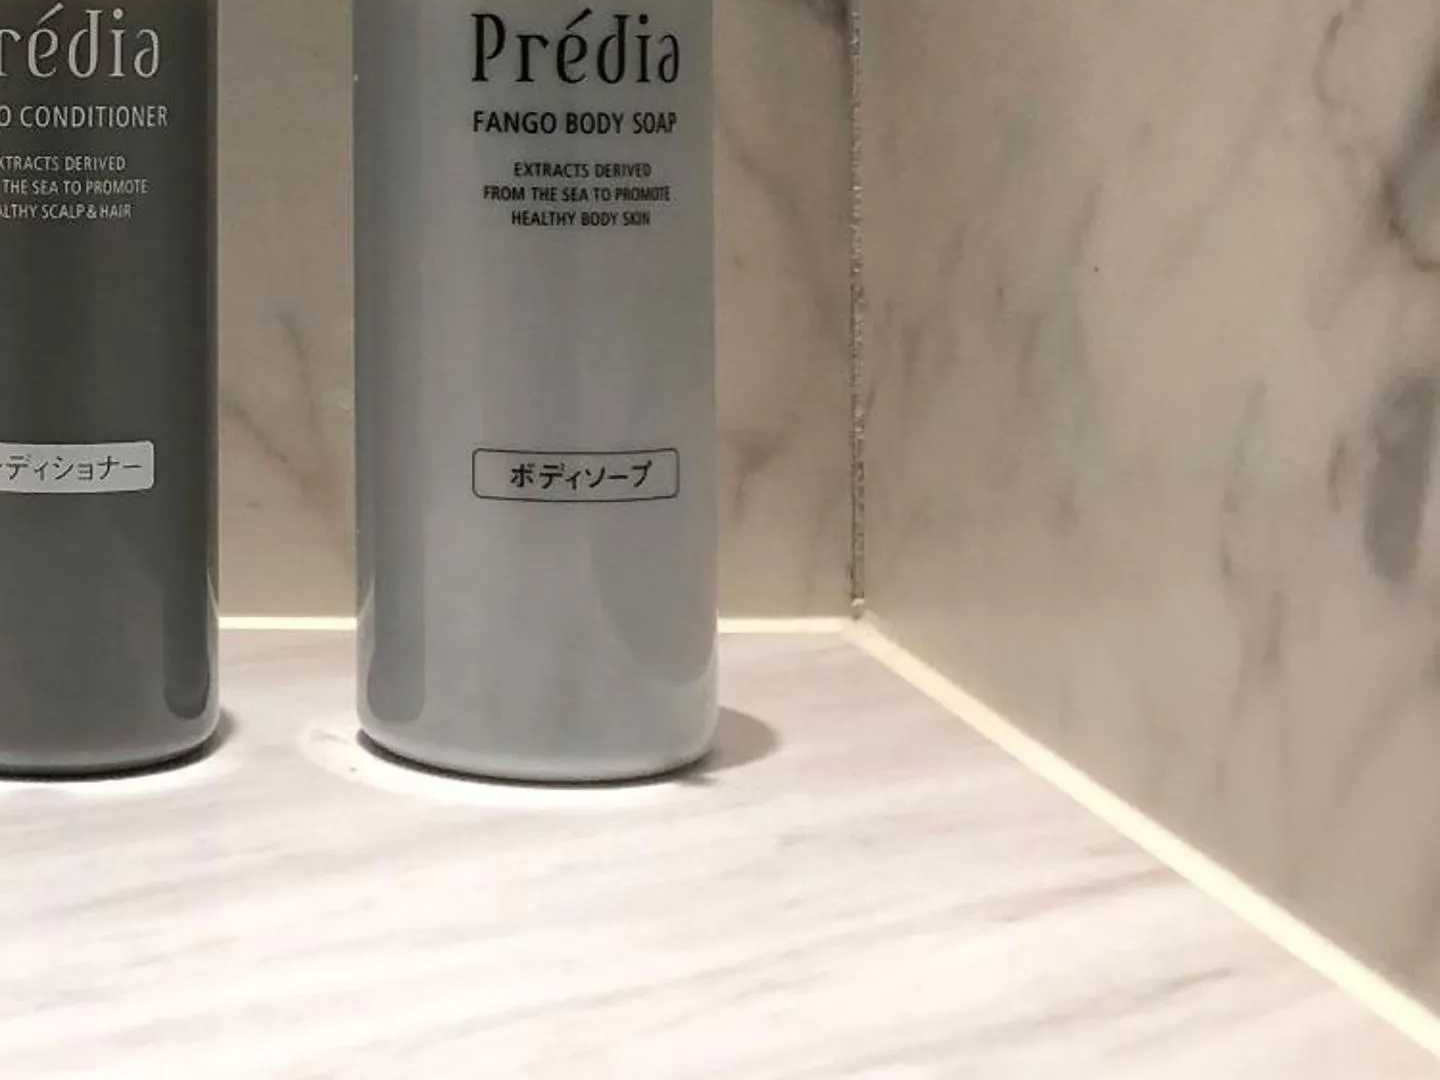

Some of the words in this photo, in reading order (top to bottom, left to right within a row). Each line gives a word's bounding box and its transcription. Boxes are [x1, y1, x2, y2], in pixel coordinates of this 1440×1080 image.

[470, 7, 681, 84] Prédia
[20, 105, 168, 128] CONDITIONER
[473, 110, 557, 134] FANGO
[566, 112, 624, 134] BODY
[633, 112, 676, 133] SOAP
[65, 156, 125, 170] DERIVED
[513, 162, 589, 178] EXTRACTS
[595, 163, 652, 178] DERIVED
[3, 180, 27, 194] THE
[32, 180, 59, 194] SEA
[64, 180, 81, 194] TO
[86, 179, 148, 194] PROMOTE
[483, 186, 525, 201] FROM
[532, 187, 557, 201] THE
[562, 187, 588, 202] SEA
[594, 187, 611, 202] TO
[616, 186, 670, 202] PROMOTE
[42, 204, 84, 219] SCALP
[100, 203, 132, 218] HAIR
[512, 210, 576, 226] HEALTHY
[581, 211, 618, 226] BODY
[623, 211, 650, 225] SKIN
[510, 460, 652, 490] ボディソープ
